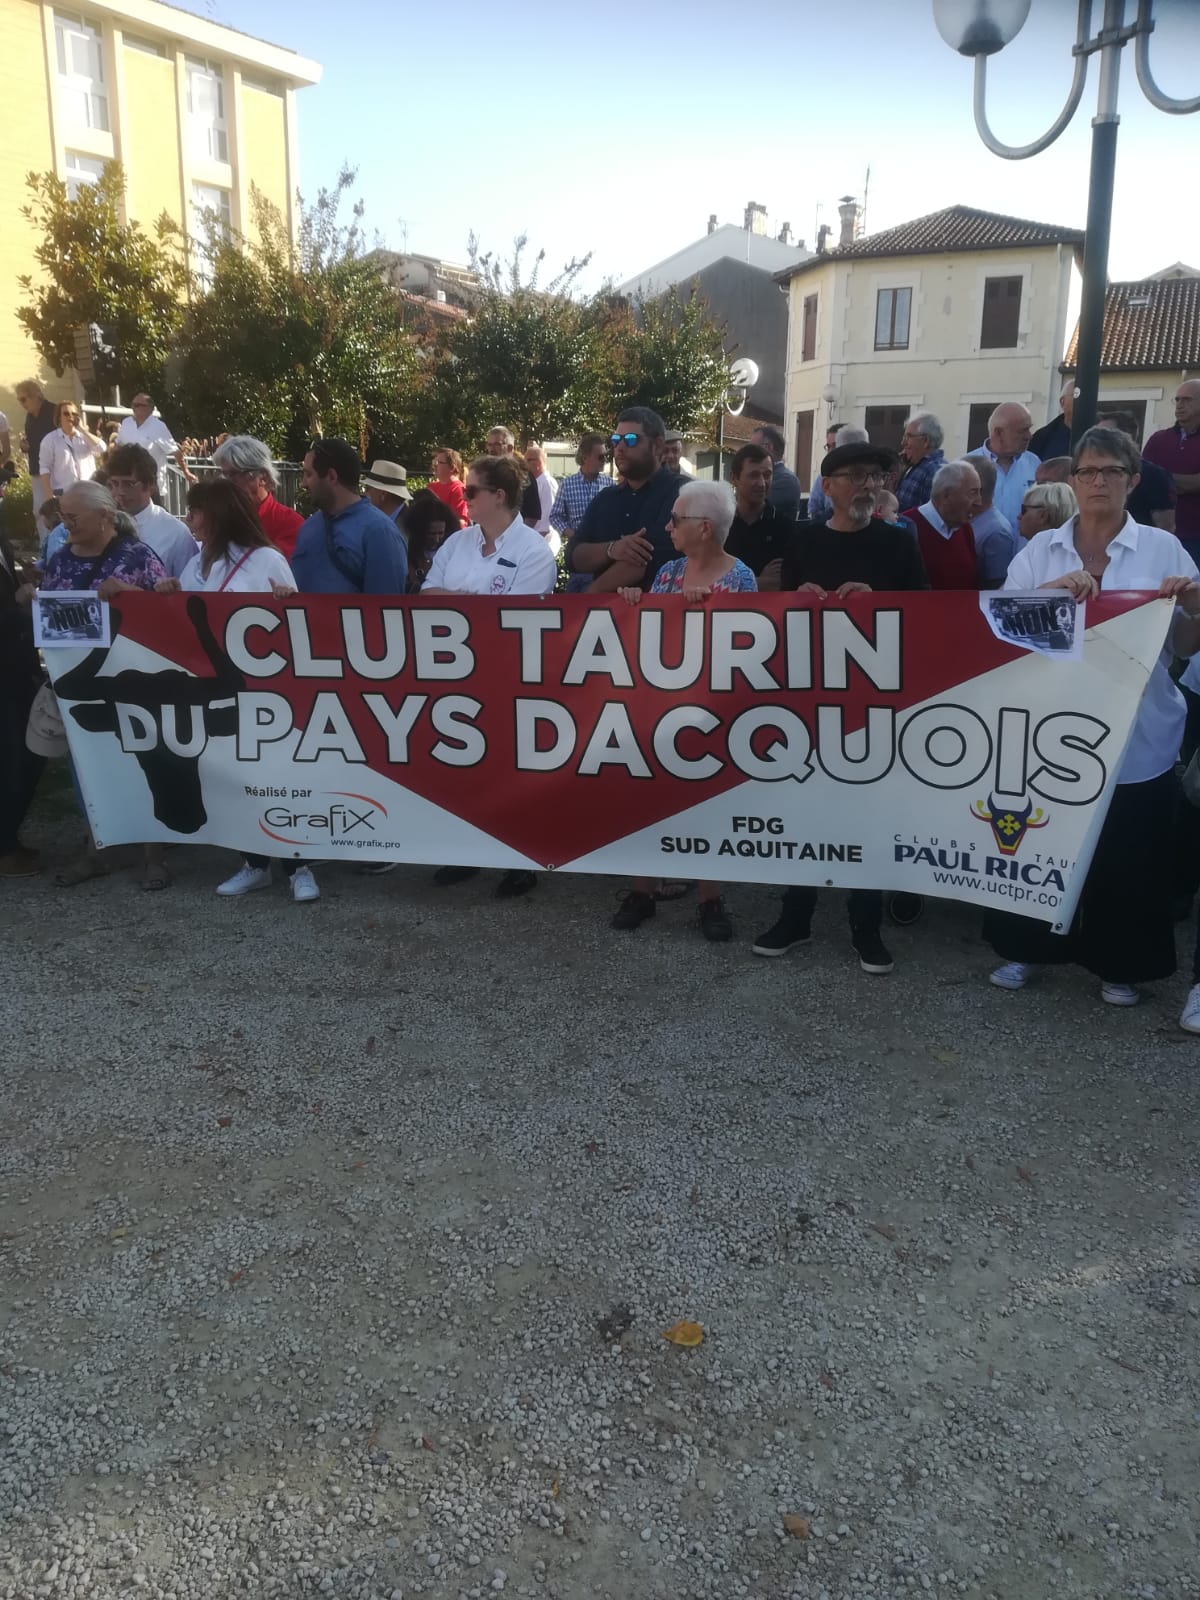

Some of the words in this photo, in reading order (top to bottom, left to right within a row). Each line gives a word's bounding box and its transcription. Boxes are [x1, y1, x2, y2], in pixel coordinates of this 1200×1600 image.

[1002, 604, 1058, 637] NON
[225, 606, 477, 680] CLUB
[500, 608, 900, 693] TAURIN
[115, 699, 207, 757] DU
[236, 692, 486, 767] PAYS
[515, 697, 1110, 805] DACQUOIS
[245, 786, 287, 798] Réalisé
[291, 788, 312, 799] par
[732, 816, 784, 834] FDG
[331, 839, 400, 849] www.grafix.pro
[661, 836, 710, 854] SUD
[718, 839, 862, 862] AQUITAINE
[894, 834, 976, 850] CLUBS
[1035, 853, 1076, 869] TAU
[894, 844, 979, 873] PAUL
[933, 871, 1062, 908] www.uctpr.co
